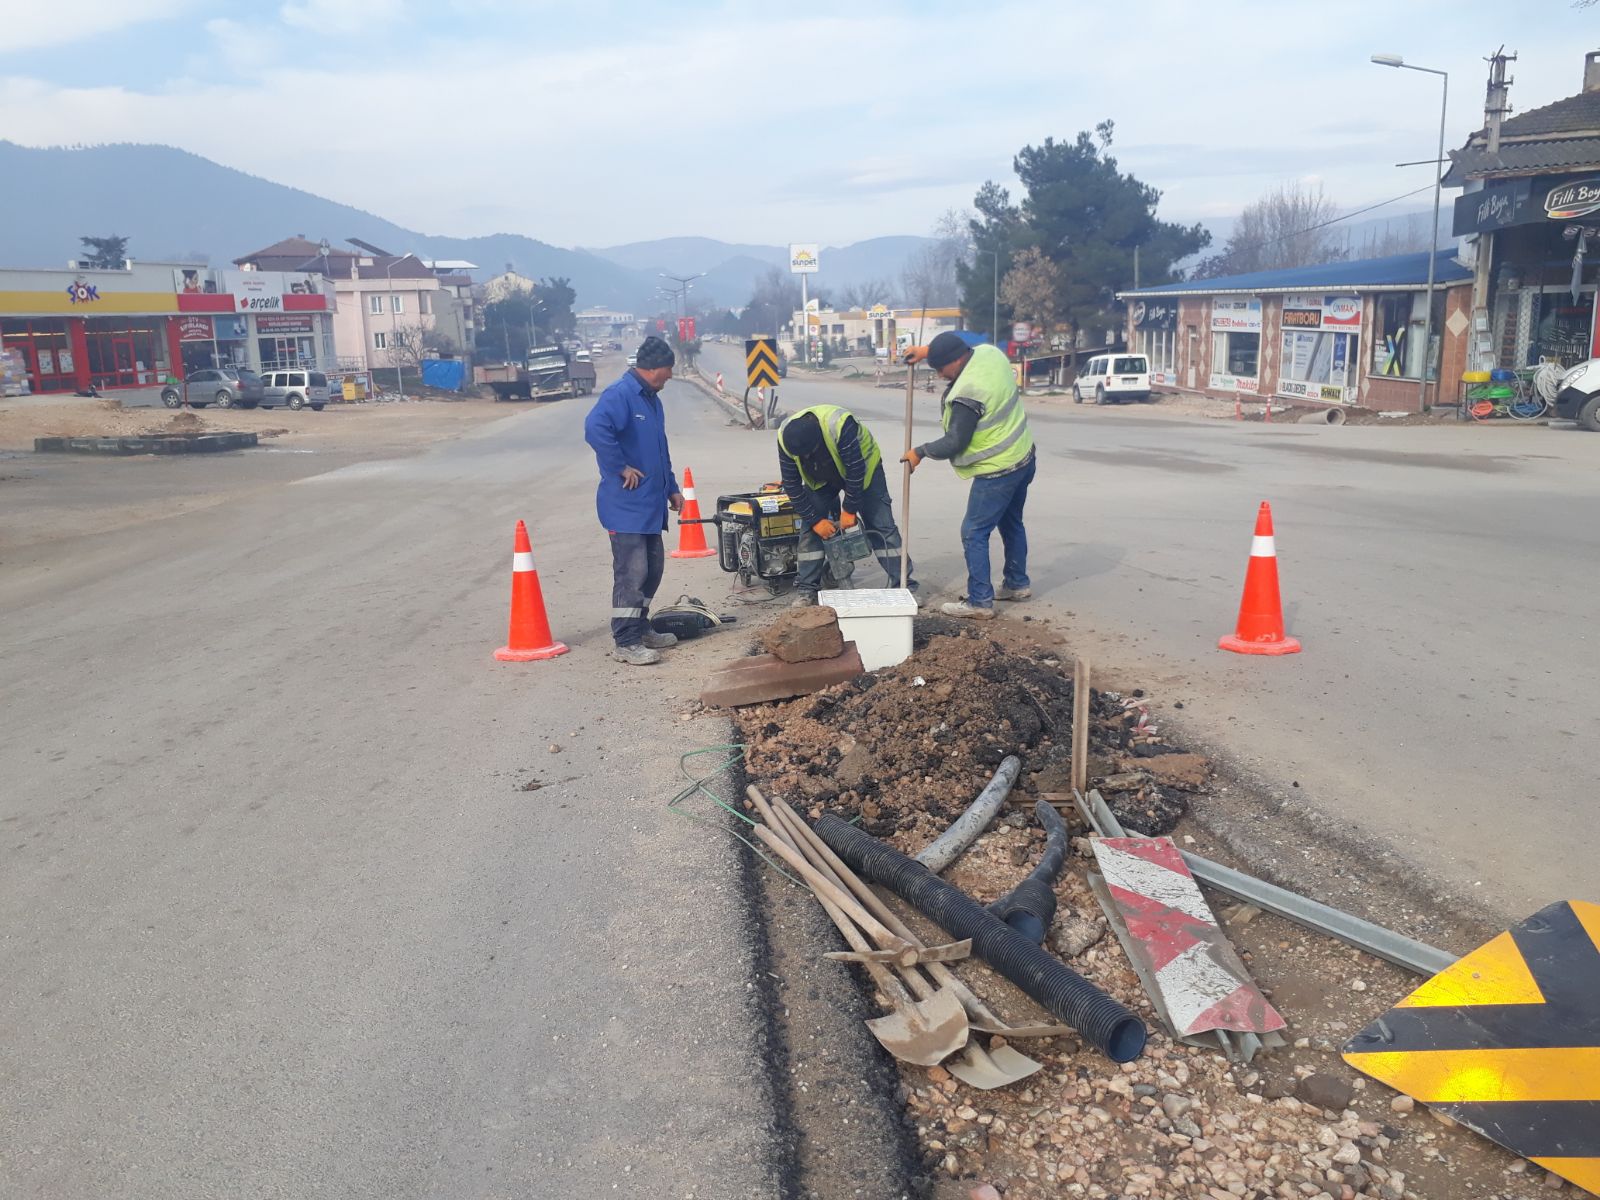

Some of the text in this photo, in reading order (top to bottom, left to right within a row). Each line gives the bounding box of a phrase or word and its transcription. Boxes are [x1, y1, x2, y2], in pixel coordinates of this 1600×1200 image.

[1550, 188, 1575, 208] Filli
[1577, 186, 1600, 203] Boy
[1477, 201, 1490, 225] Filli
[1490, 195, 1509, 219] Boya
[792, 258, 817, 267] sunpet
[250, 296, 280, 311] arçelik
[868, 311, 892, 319] sunpet
